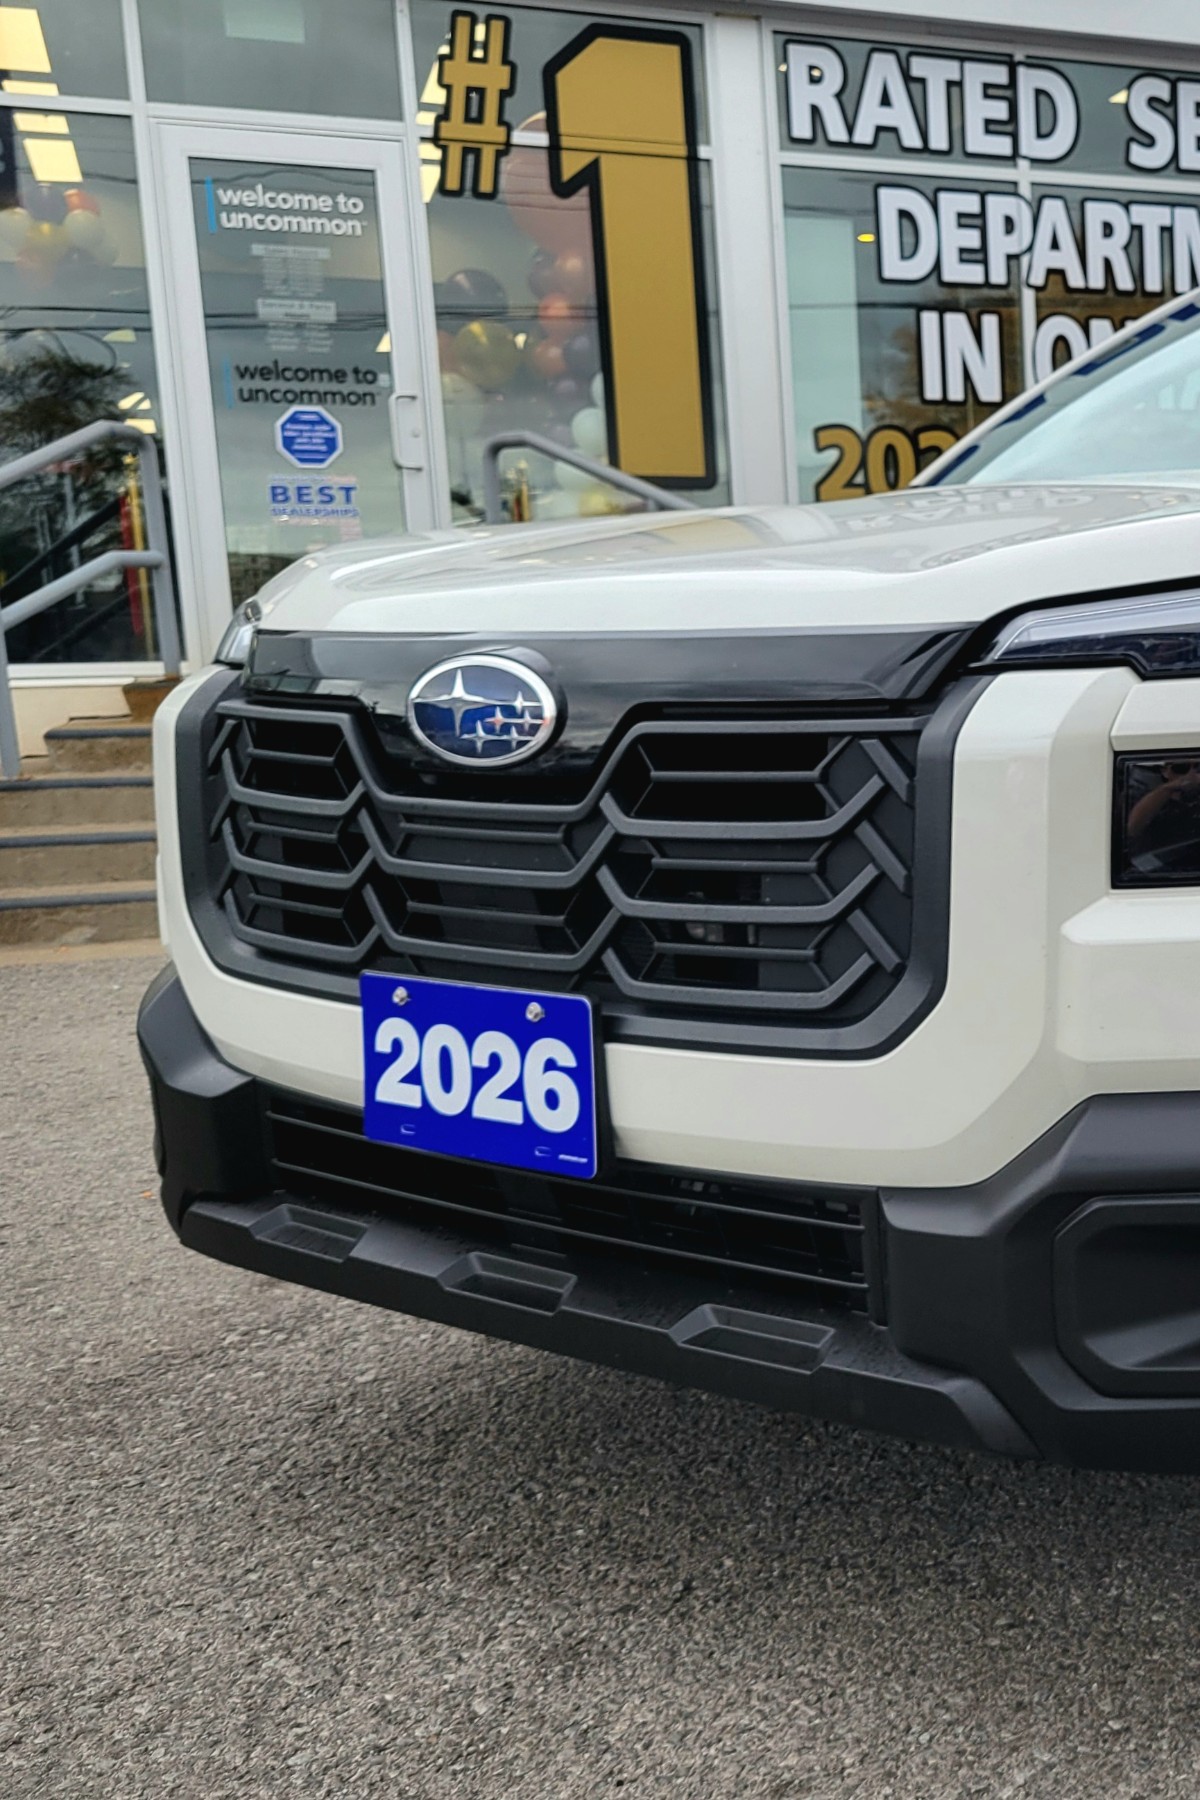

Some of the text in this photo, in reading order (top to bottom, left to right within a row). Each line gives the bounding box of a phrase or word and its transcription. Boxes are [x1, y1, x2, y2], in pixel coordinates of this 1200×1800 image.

[785, 42, 1078, 161] RATED
[217, 183, 364, 214] welcome to
[220, 211, 362, 236] uncommon
[436, 10, 717, 488] #1
[235, 359, 377, 384] welcome to
[920, 311, 1001, 403] IN
[238, 388, 376, 406] uncommon
[270, 485, 357, 504] BEST
[374, 1016, 581, 1133] 2026
